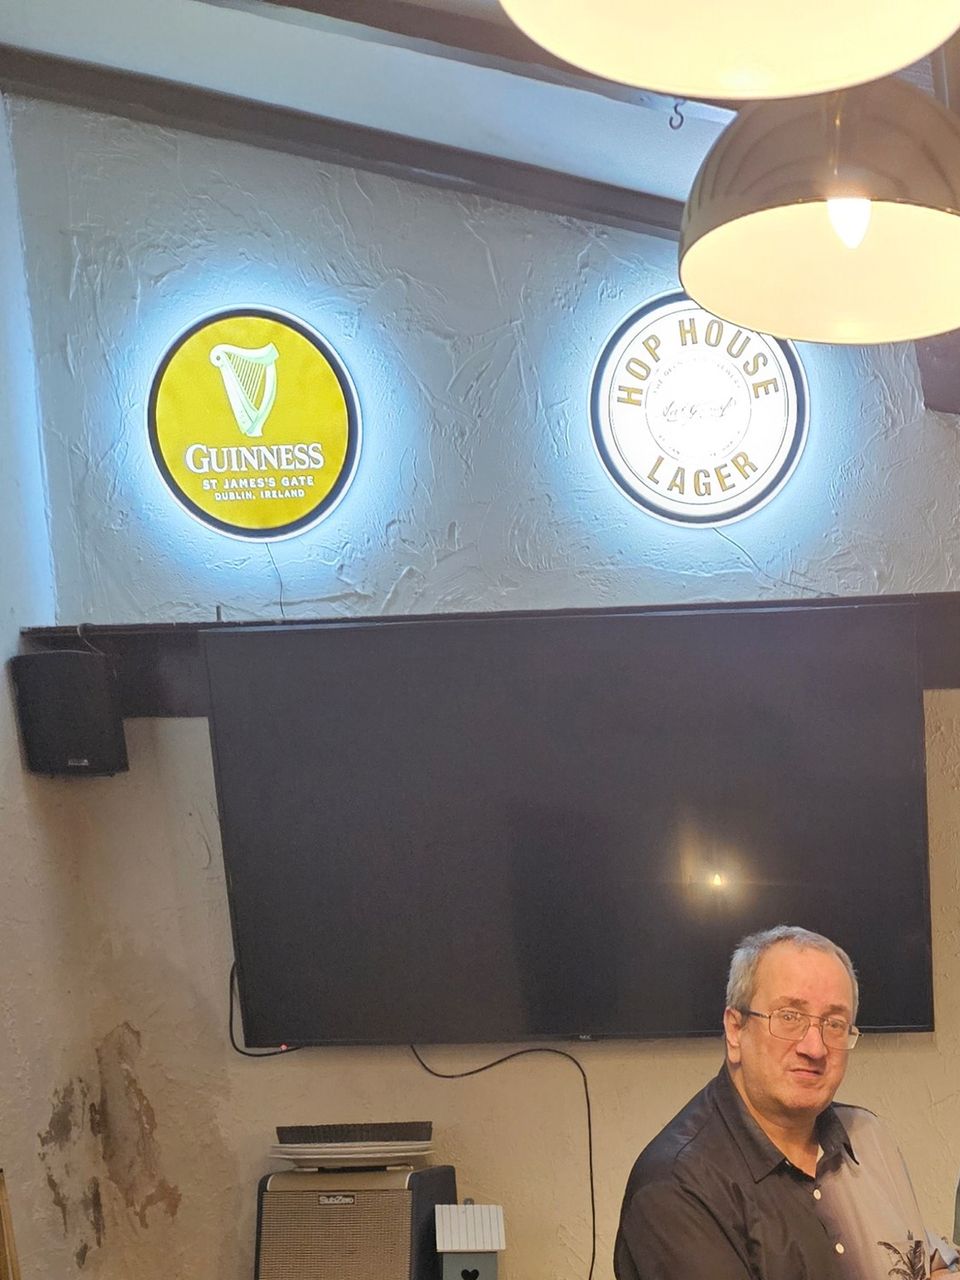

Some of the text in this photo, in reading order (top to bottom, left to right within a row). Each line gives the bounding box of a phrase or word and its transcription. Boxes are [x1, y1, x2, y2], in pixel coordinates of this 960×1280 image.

[617, 334, 661, 407] HOP
[679, 317, 780, 399] HOUSE
[184, 443, 324, 474] GUINNESS
[647, 451, 758, 497] LAGER
[202, 476, 314, 490] ST JAMES'S GATE
[260, 489, 305, 499] IRELAND
